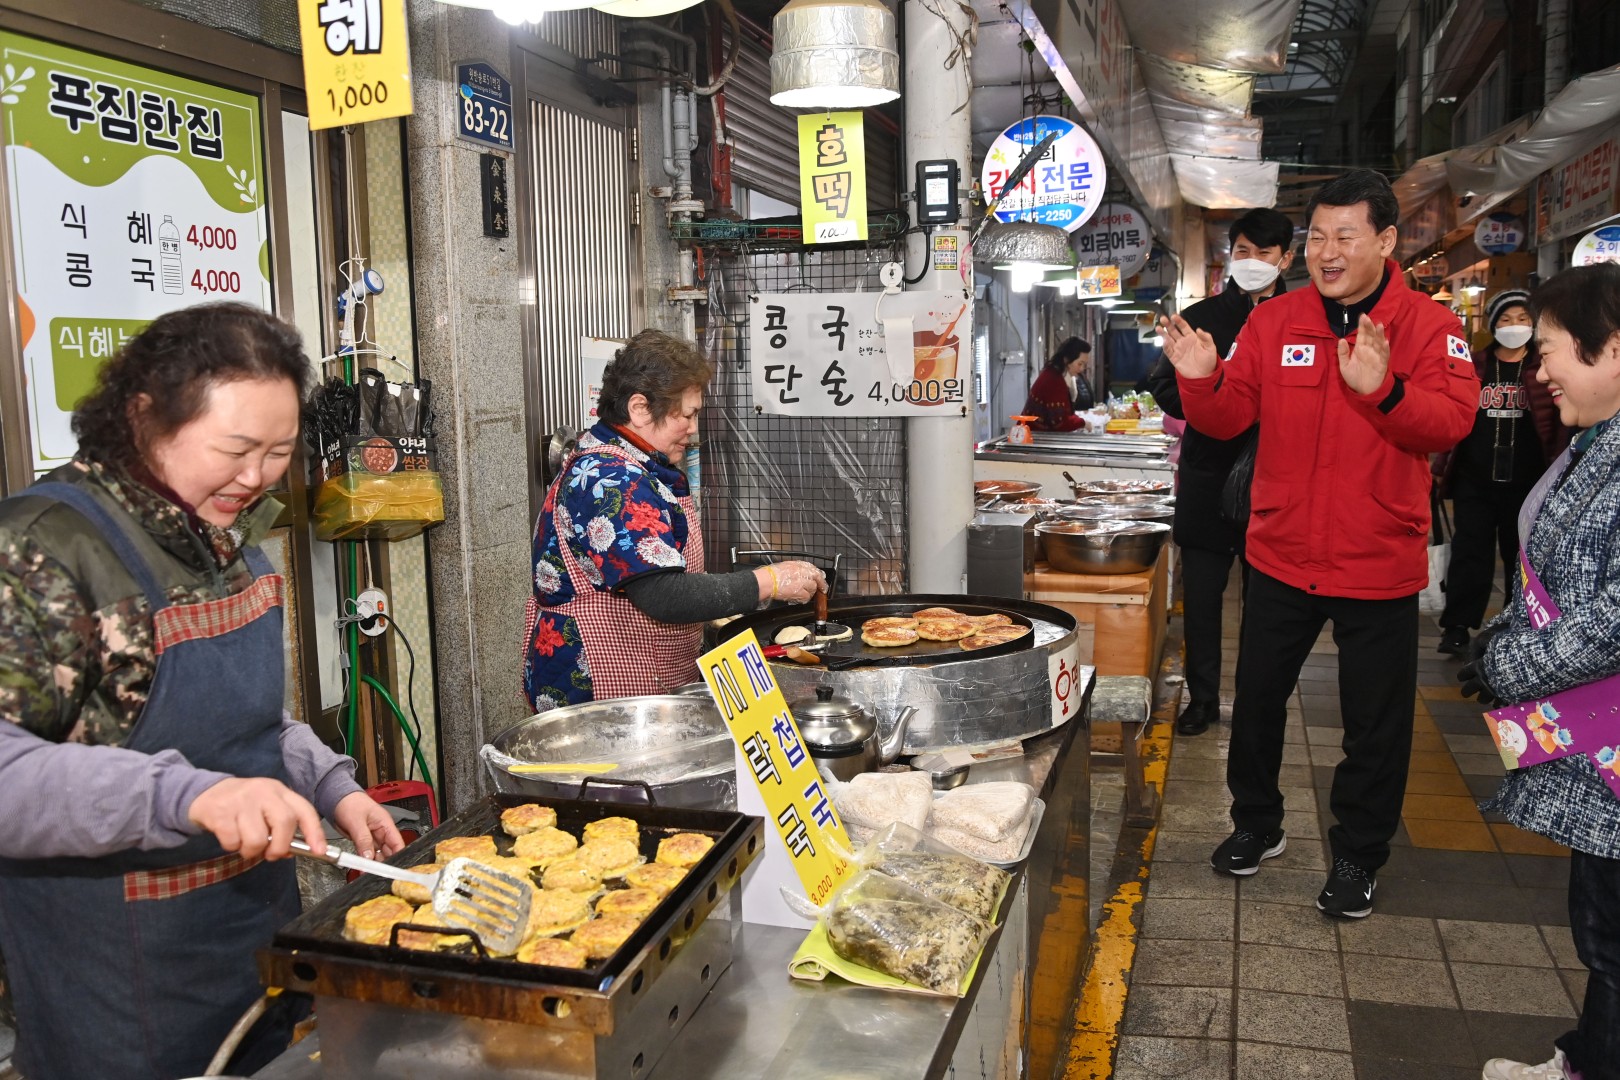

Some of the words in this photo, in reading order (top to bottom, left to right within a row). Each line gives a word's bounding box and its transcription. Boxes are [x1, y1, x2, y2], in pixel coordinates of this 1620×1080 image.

[318, 0, 383, 56] 혜
[327, 81, 388, 116] 1,000
[49, 72, 224, 162] 푸짐한집
[464, 98, 509, 141] 83-22
[812, 124, 851, 218] 호떡
[187, 224, 236, 250] 4,000
[191, 269, 240, 294] 4,000
[867, 378, 964, 406] 4,000원
[327, 439, 340, 461] 양념
[399, 437, 426, 454] 양념
[402, 456, 429, 471] 쌈장
[737, 642, 839, 830] 재첩국
[710, 657, 816, 858] 시락국
[811, 875, 832, 906] 3,000
